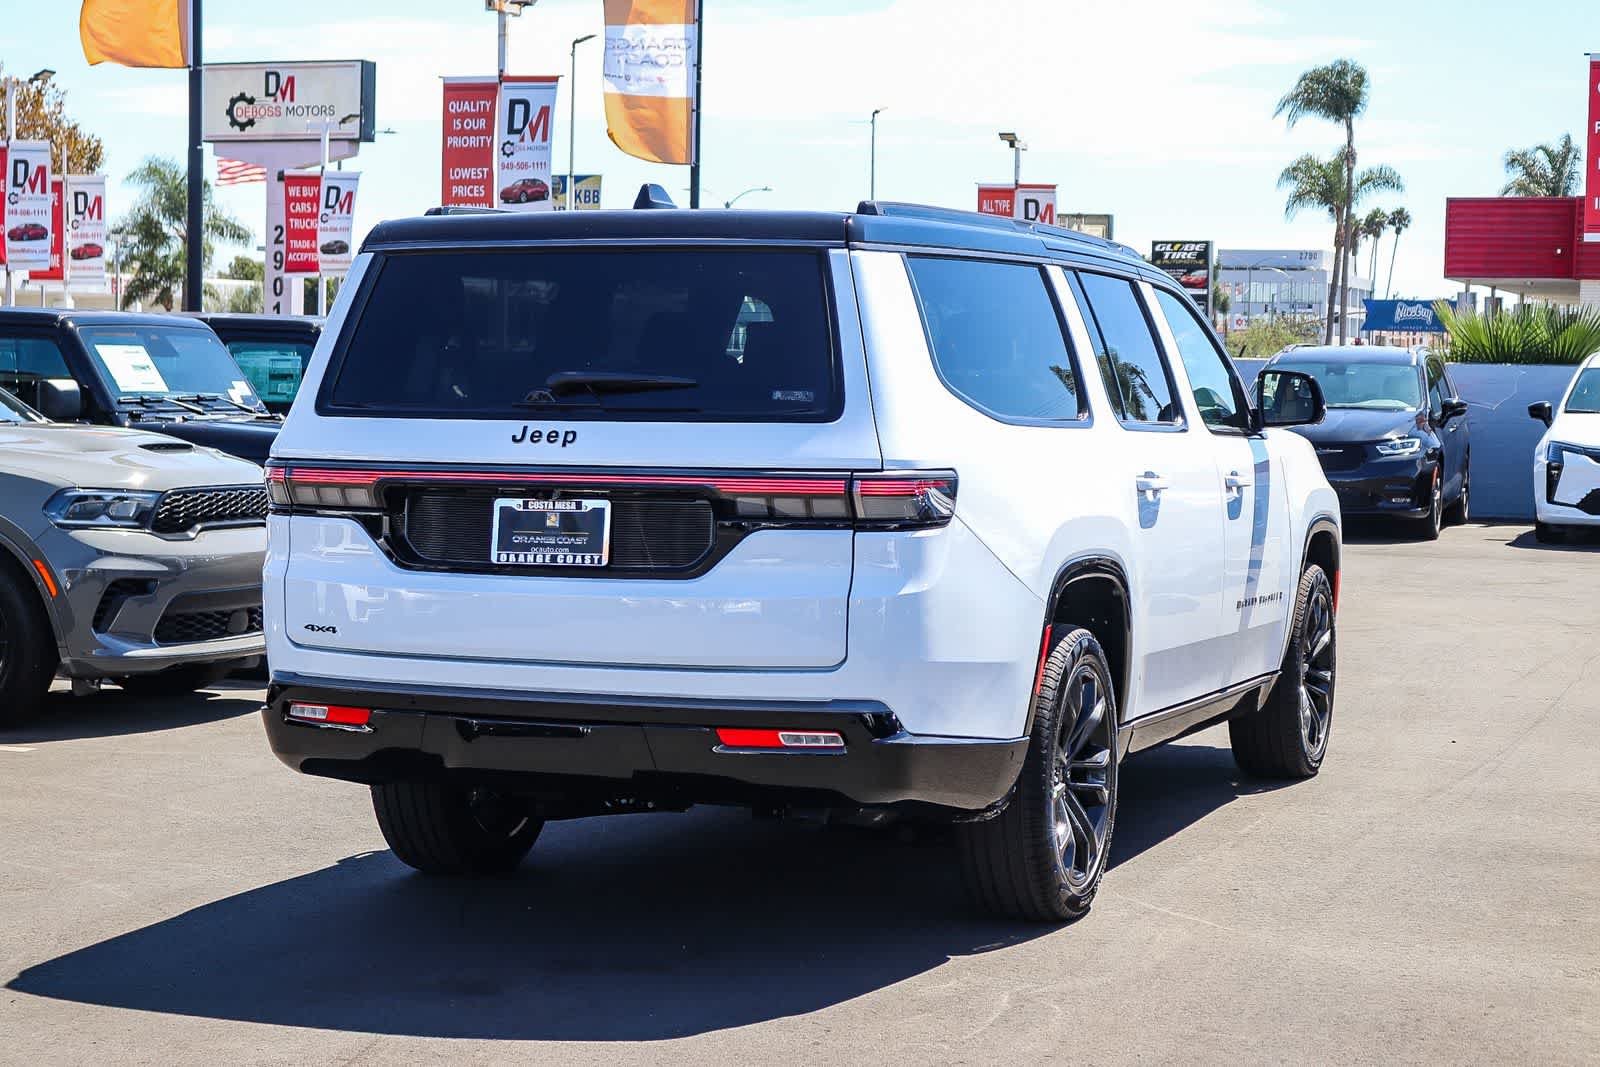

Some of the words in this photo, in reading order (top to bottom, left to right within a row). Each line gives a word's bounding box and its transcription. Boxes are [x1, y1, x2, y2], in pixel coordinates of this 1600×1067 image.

[235, 105, 282, 118] DEBOSS
[285, 104, 336, 117] MOTORS
[448, 100, 492, 113] QUALITY
[453, 118, 461, 130] IS
[463, 118, 486, 130] OUR
[447, 136, 492, 148] PRIORITY
[449, 167, 489, 180] LOWEST
[288, 186, 300, 196] WE
[302, 186, 319, 196] BUY
[452, 185, 485, 197] PRICES
[574, 189, 600, 204] KBB
[290, 202, 311, 213] CARS
[982, 200, 994, 211] ALL
[995, 200, 1011, 212] TYPE
[511, 425, 577, 448] Jeep
[528, 501, 553, 510] COSTA
[555, 501, 577, 510] MESA
[512, 535, 556, 545] ORANGE
[556, 535, 589, 545] COAST
[500, 553, 552, 563] ORANGE
[557, 554, 600, 564] COAST
[303, 623, 338, 634] 4x4
